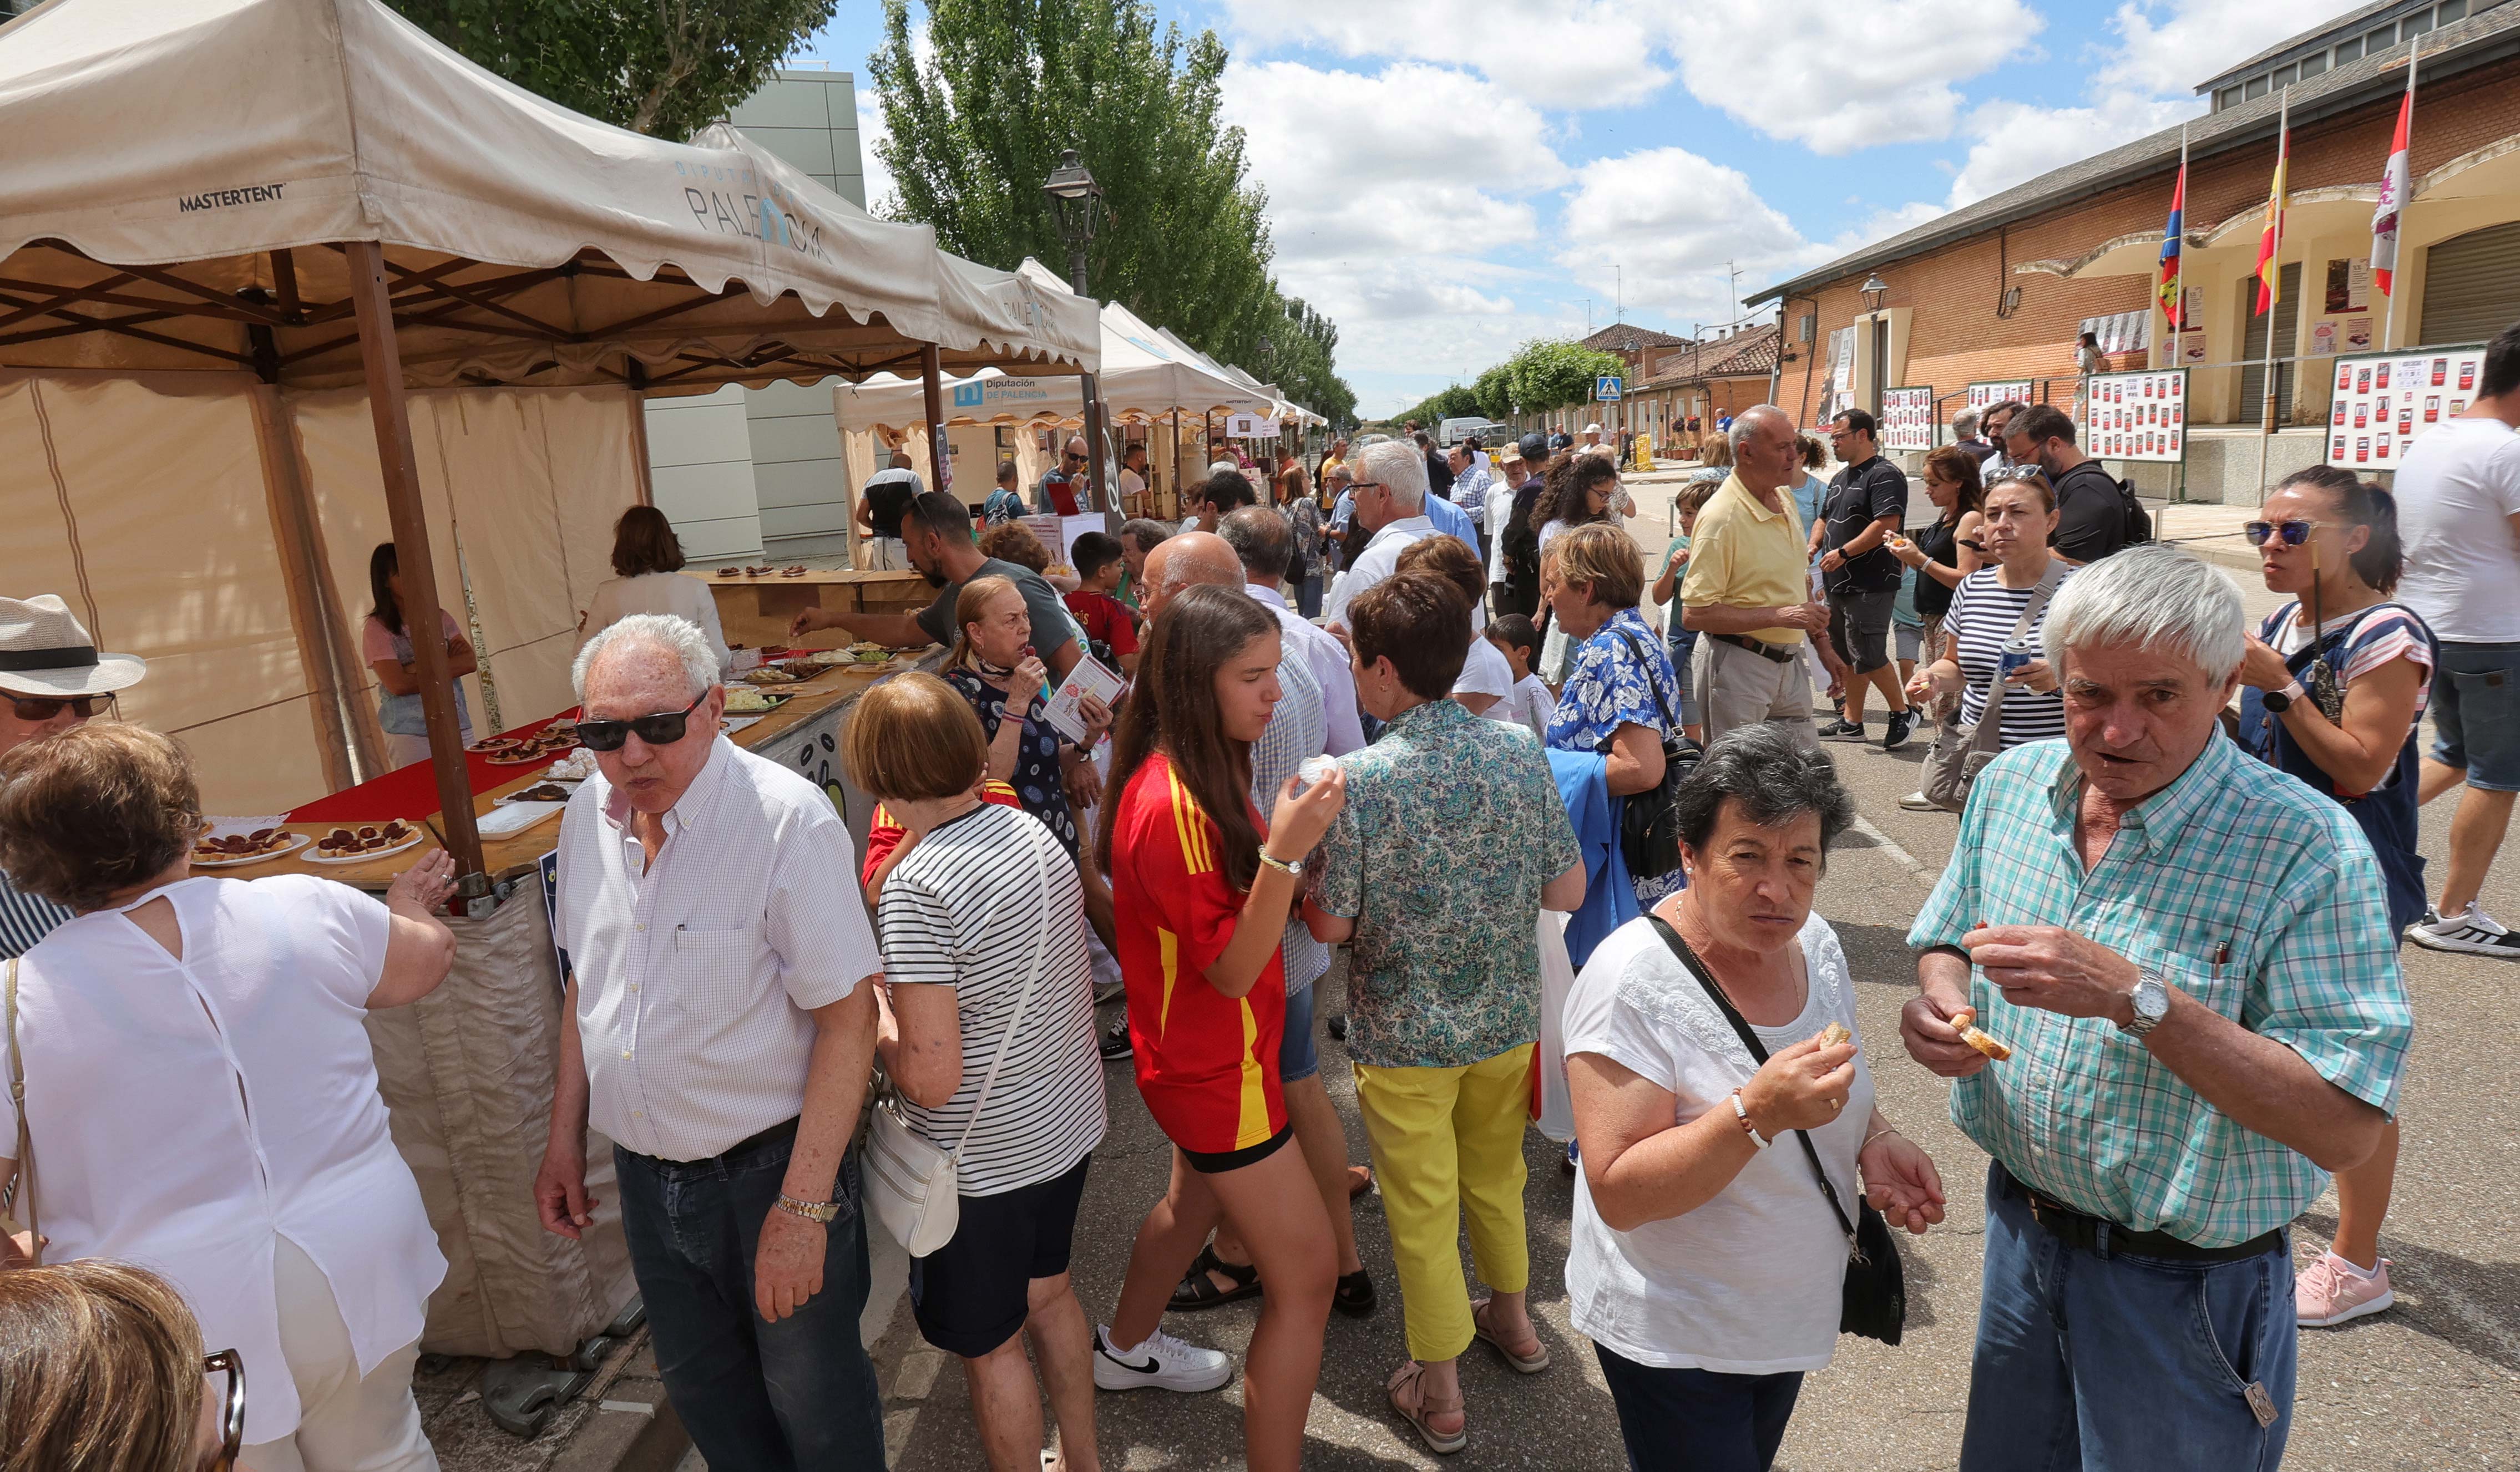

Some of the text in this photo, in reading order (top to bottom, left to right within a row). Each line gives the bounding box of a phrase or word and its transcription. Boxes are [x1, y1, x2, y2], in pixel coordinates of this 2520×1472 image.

[180, 183, 284, 212] MASTERTENT
[986, 379, 1035, 388] Diputación
[1001, 390, 1048, 399] PALENCIA
